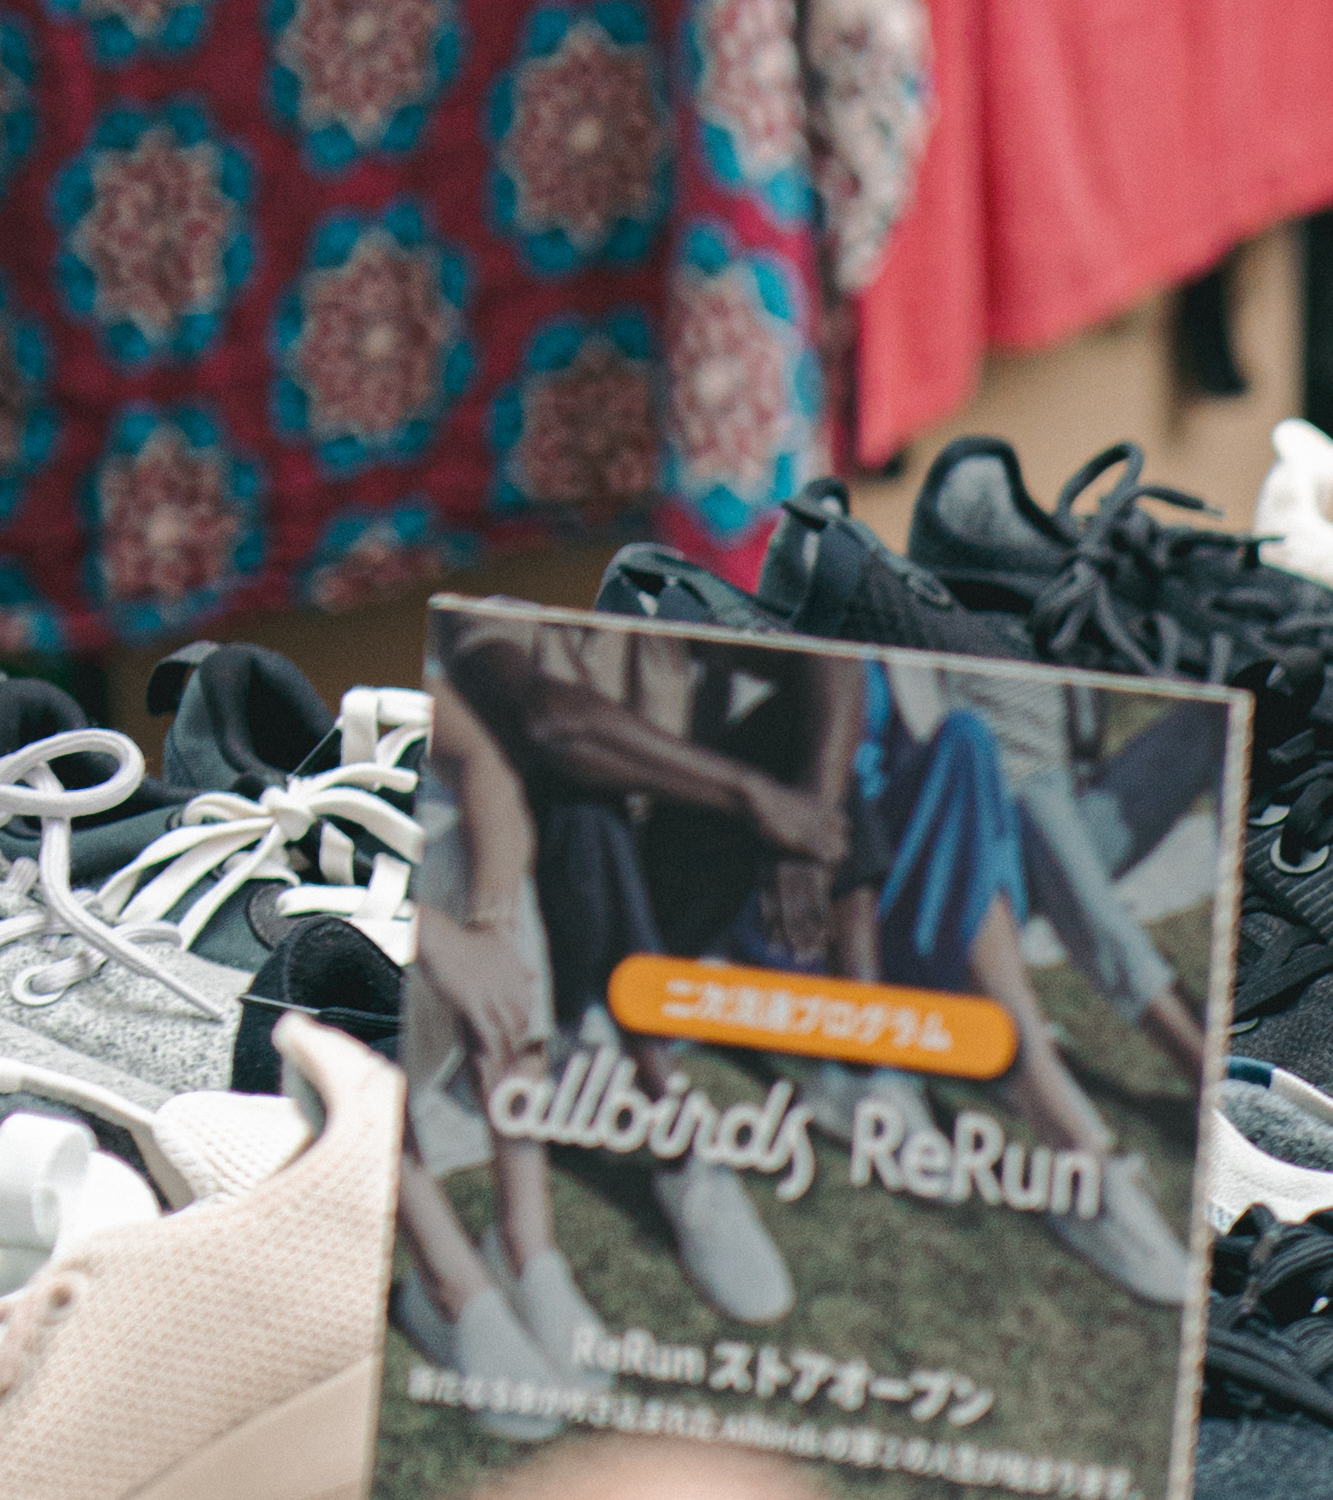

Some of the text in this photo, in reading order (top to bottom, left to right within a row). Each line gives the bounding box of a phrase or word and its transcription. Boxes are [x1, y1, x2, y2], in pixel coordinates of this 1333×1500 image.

[490, 1048, 1102, 1217] allbirds ReRun
[573, 1327, 995, 1427] ReRun ストアオープン
